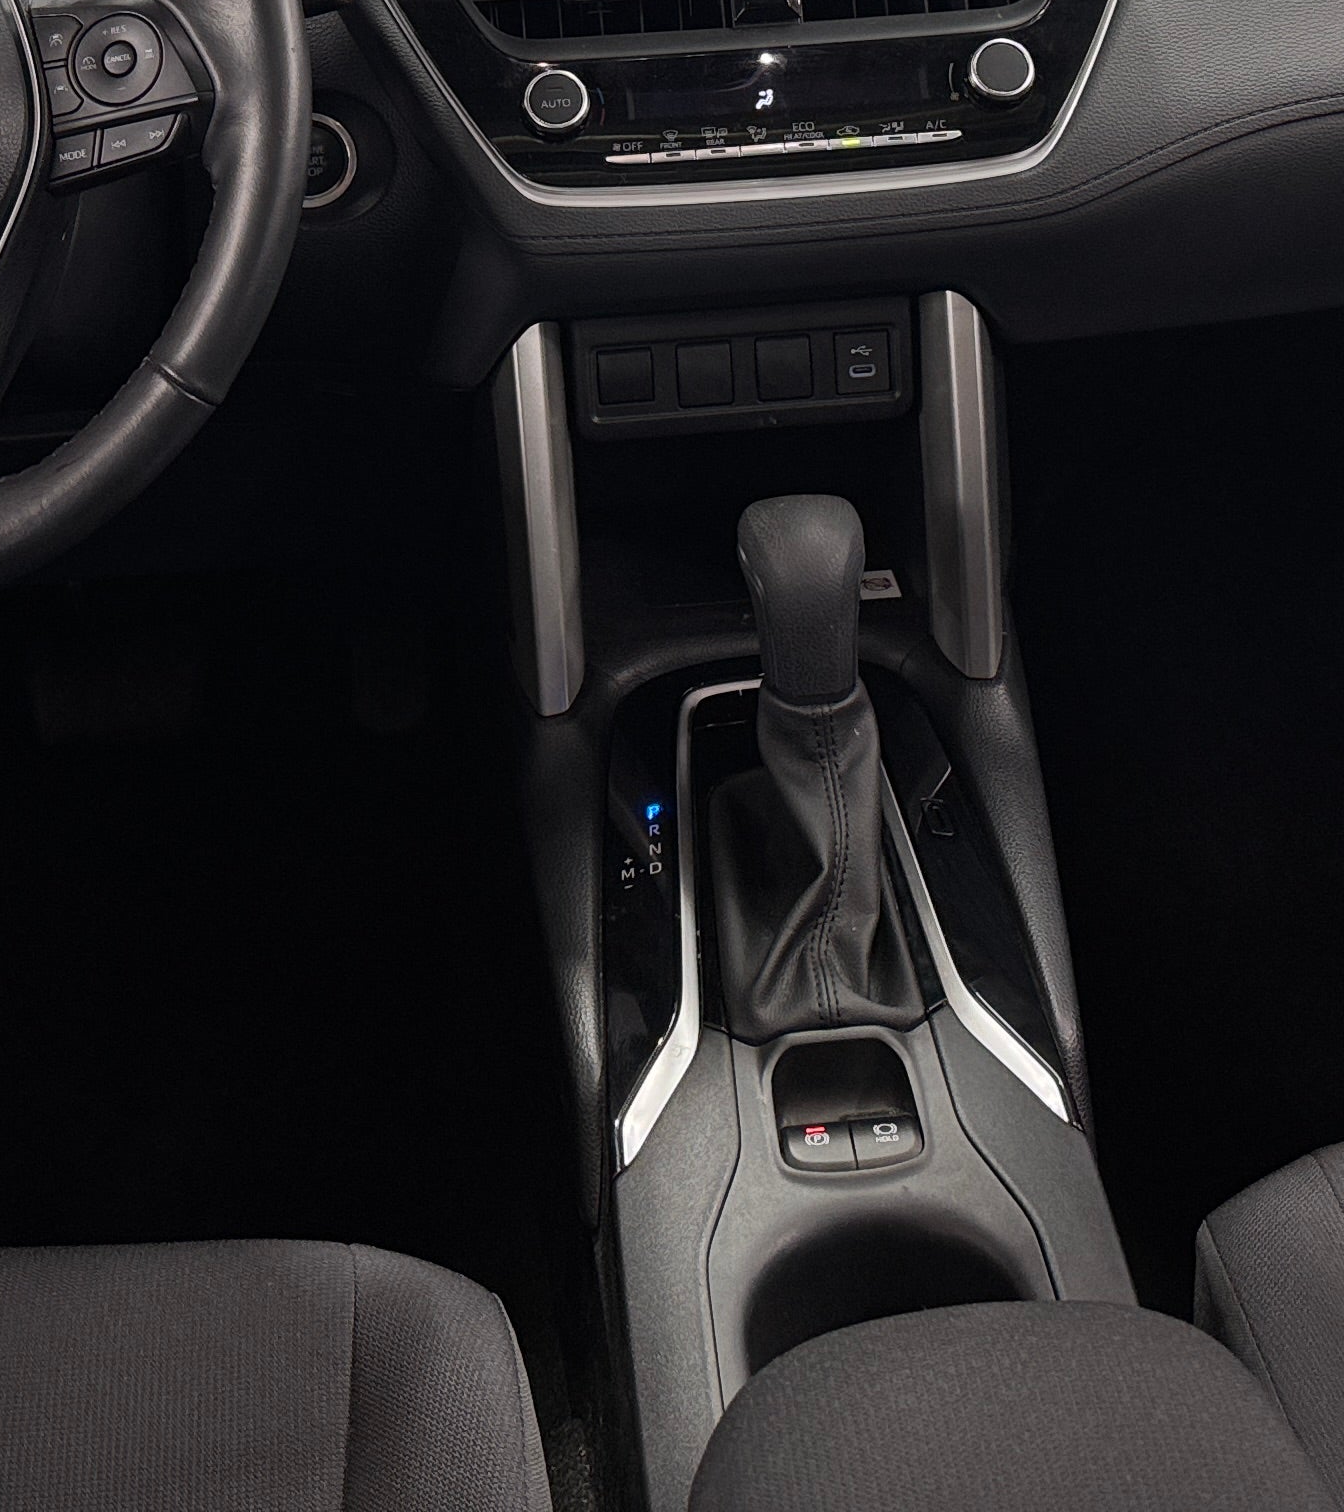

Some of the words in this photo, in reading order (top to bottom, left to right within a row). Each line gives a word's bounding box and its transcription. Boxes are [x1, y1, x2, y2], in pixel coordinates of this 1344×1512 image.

[106, 53, 131, 64] CANCEL
[540, 98, 571, 109] AUTO
[792, 122, 815, 132] ECO
[926, 119, 947, 131] A/C
[622, 142, 644, 153] OFF
[660, 142, 682, 150] FRONT
[706, 138, 725, 146] REAR
[59, 148, 88, 163] MODE
[647, 802, 661, 821] P
[649, 824, 660, 837] R
[649, 842, 662, 856] N
[650, 861, 662, 875] D
[621, 867, 635, 881] M
[875, 1134, 900, 1143] HOLD
